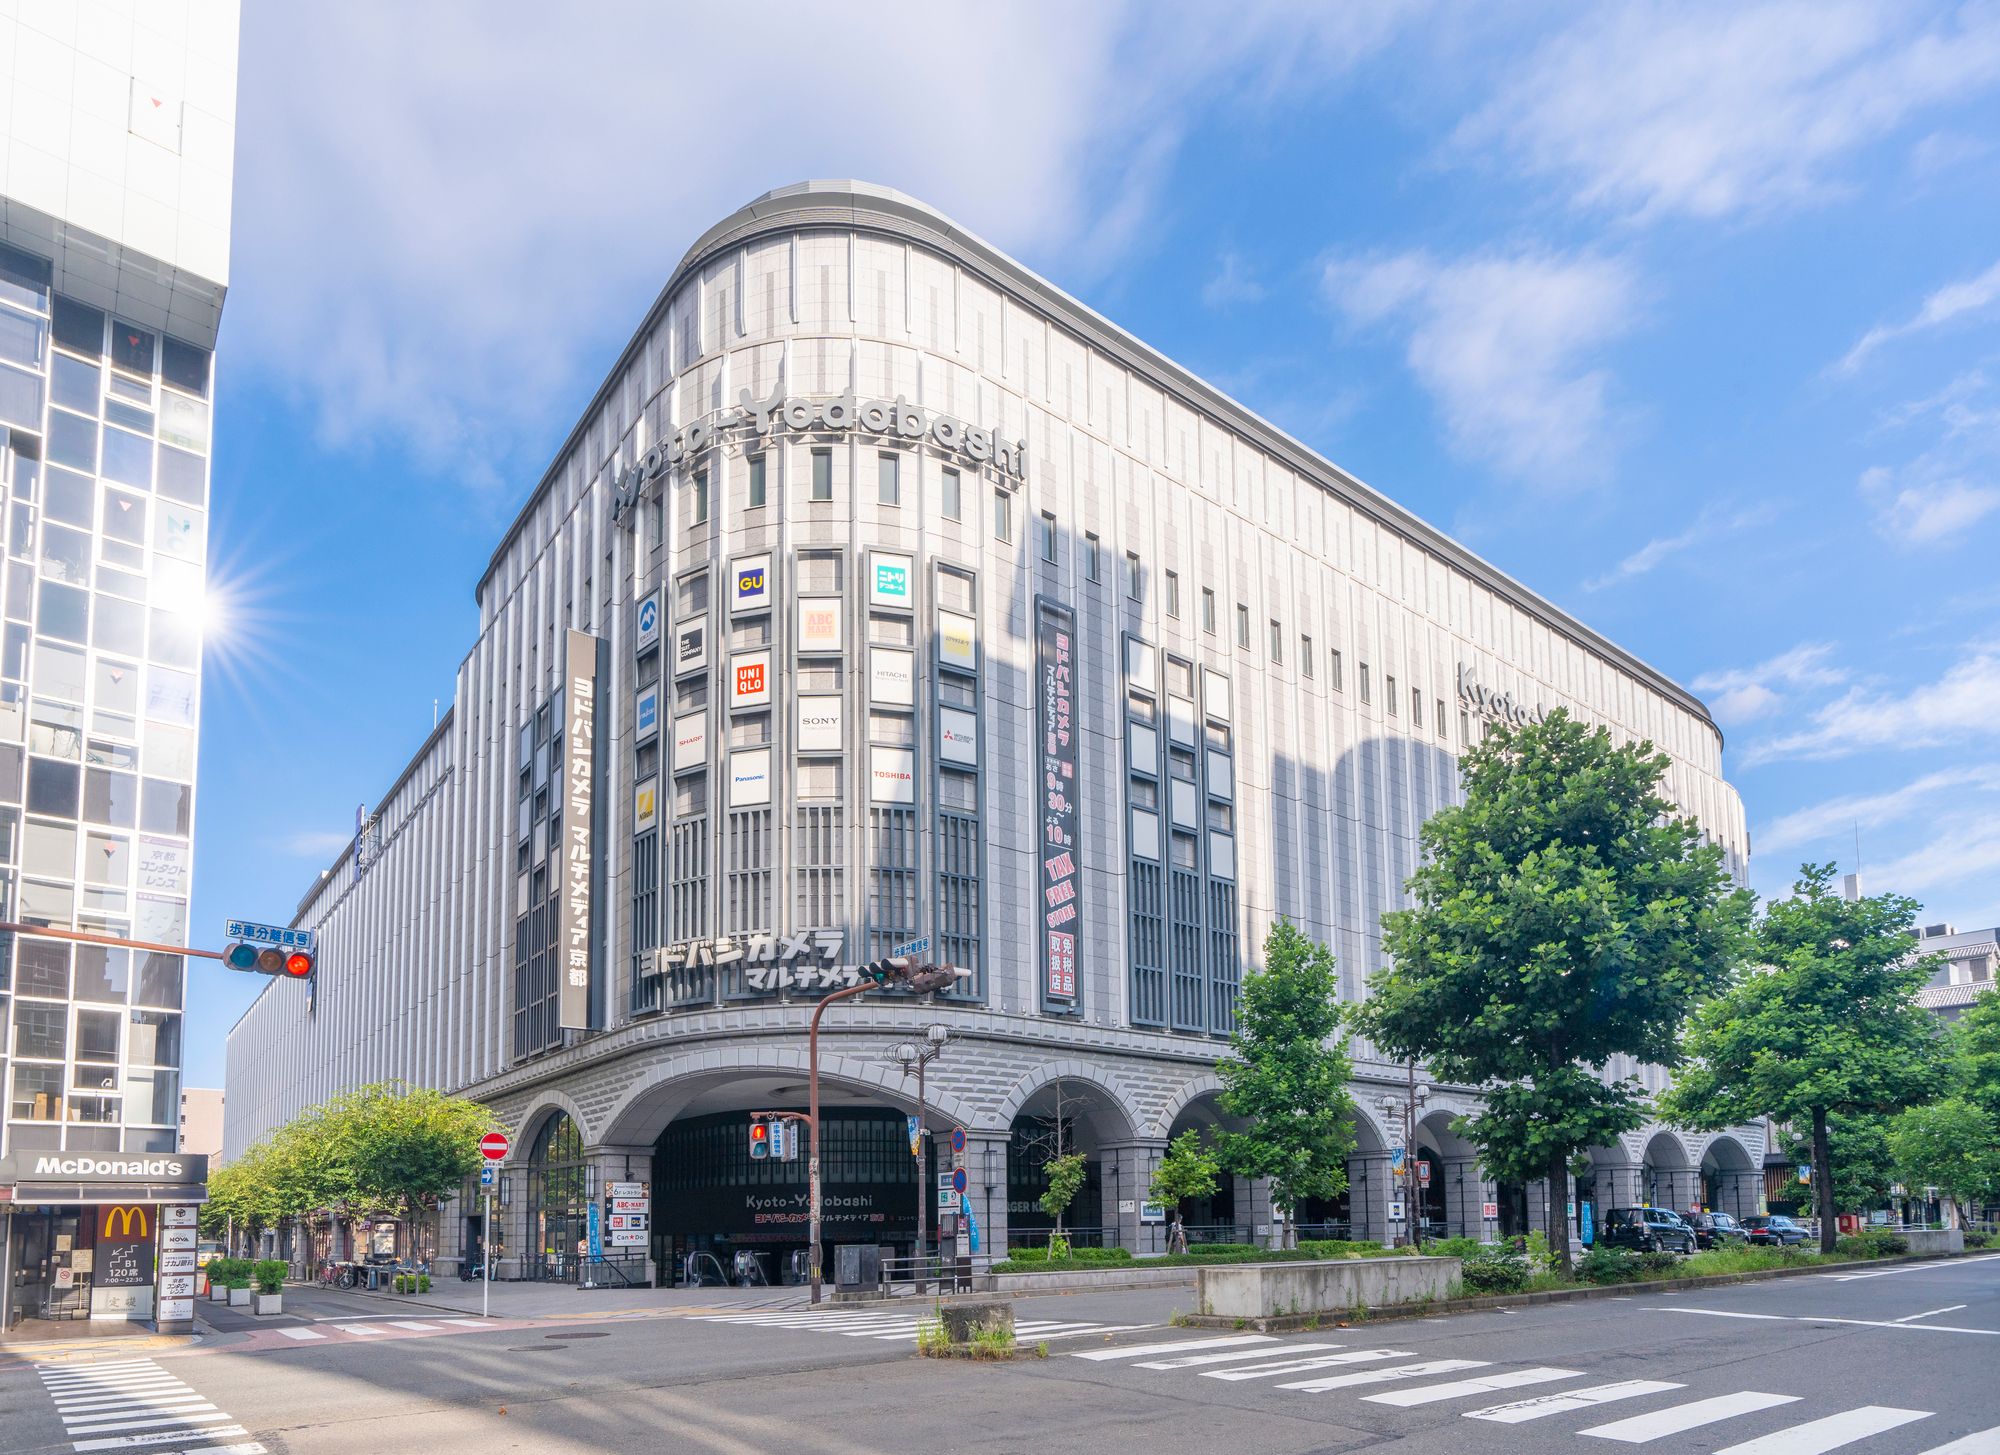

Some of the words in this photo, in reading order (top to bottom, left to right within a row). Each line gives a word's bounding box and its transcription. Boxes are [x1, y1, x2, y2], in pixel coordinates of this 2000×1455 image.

[613, 382, 1027, 521] Kyoto-Yodobashi
[739, 575, 764, 591] GU
[878, 570, 904, 583] ニトリ
[808, 614, 832, 625] ABC
[681, 646, 702, 658] COMPANY
[740, 667, 760, 680] UNI
[876, 670, 908, 679] HITACHI
[740, 679, 761, 692] QLO
[1056, 632, 1070, 747] ヨドバシカメラ
[802, 717, 838, 725] SONY
[571, 677, 593, 816] ヨドバシカメラ
[679, 735, 703, 746] SHARP
[735, 773, 765, 782] Panasonic
[874, 771, 911, 780] TOSHIBA
[639, 809, 654, 822] Nikon
[139, 861, 186, 876] コンタクト
[1045, 851, 1075, 881] TAX
[146, 876, 176, 889] レンズ
[1046, 879, 1075, 908] FREE
[569, 826, 591, 987] マルチメディア京都
[1047, 903, 1076, 928] STORE
[229, 923, 308, 946] 歩車分離信号
[641, 931, 844, 978] ヨドバシカメラ
[35, 1157, 183, 1176] McDonald's
[746, 1194, 872, 1210] Kyoto-Yobashi
